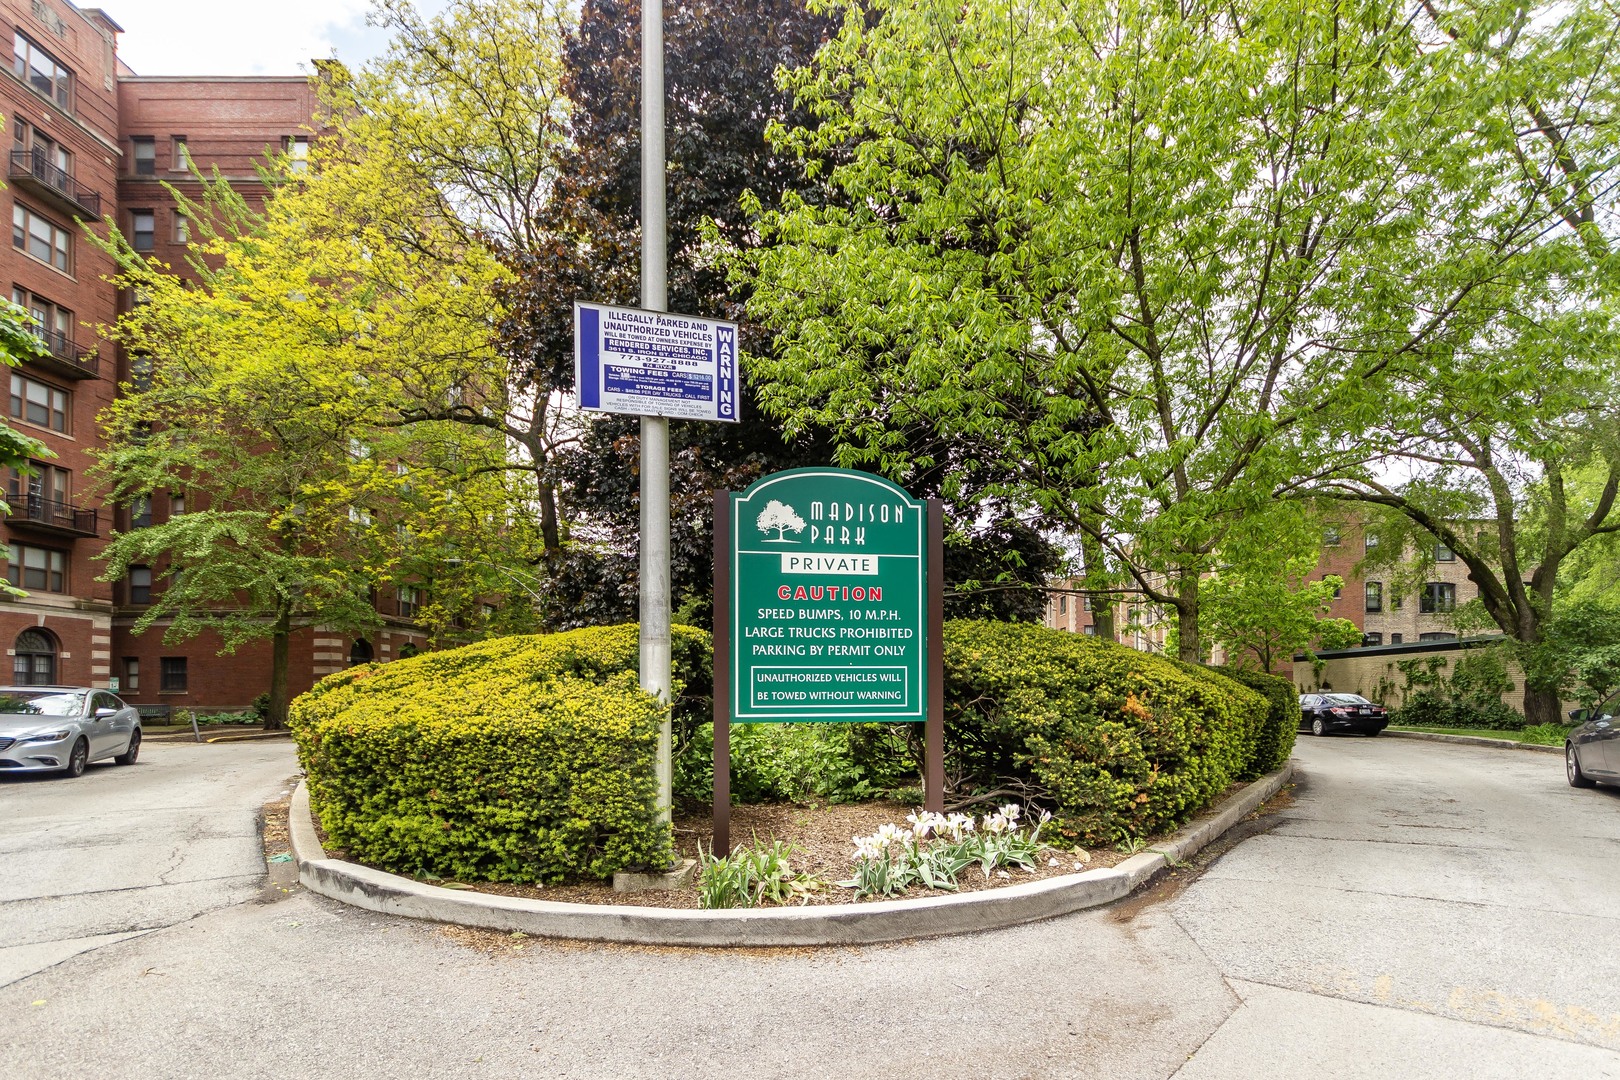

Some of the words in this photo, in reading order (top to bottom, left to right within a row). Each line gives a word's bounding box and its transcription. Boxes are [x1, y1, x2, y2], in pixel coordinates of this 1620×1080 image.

[608, 311, 654, 324] ILLEGALLY
[656, 318, 689, 329] PARKED
[691, 322, 708, 331] AND
[604, 321, 670, 336] UNAUTHORIZED
[673, 330, 712, 342] VEHICLES
[609, 339, 650, 350] RENDERED
[620, 354, 698, 366] 773-927-8888
[611, 366, 645, 374] TOWING
[717, 330, 733, 416] WARNING
[810, 501, 903, 523] MADISON
[811, 525, 865, 545] PARK
[790, 557, 870, 571] PRIVATE
[777, 585, 882, 601] CAUTION
[757, 608, 795, 620] SPEED
[799, 609, 844, 621] BUMPS,
[849, 610, 862, 620] 10
[865, 610, 901, 620] M.P.H.
[745, 627, 784, 638] LARGE
[788, 627, 836, 638] TRUCKS
[840, 628, 913, 639] PROHIBITED
[752, 645, 806, 656] PARKING
[809, 645, 824, 656] BY
[828, 645, 870, 656] PERMIT
[874, 645, 906, 656] ONLY
[757, 673, 832, 682] UNAUTHORIZED
[834, 673, 877, 682] VEHICLES
[879, 673, 901, 682] WILL
[757, 692, 769, 700] BE
[772, 692, 807, 700] TOWED
[809, 691, 854, 700] WITHOUT
[857, 691, 901, 700] WARNING
